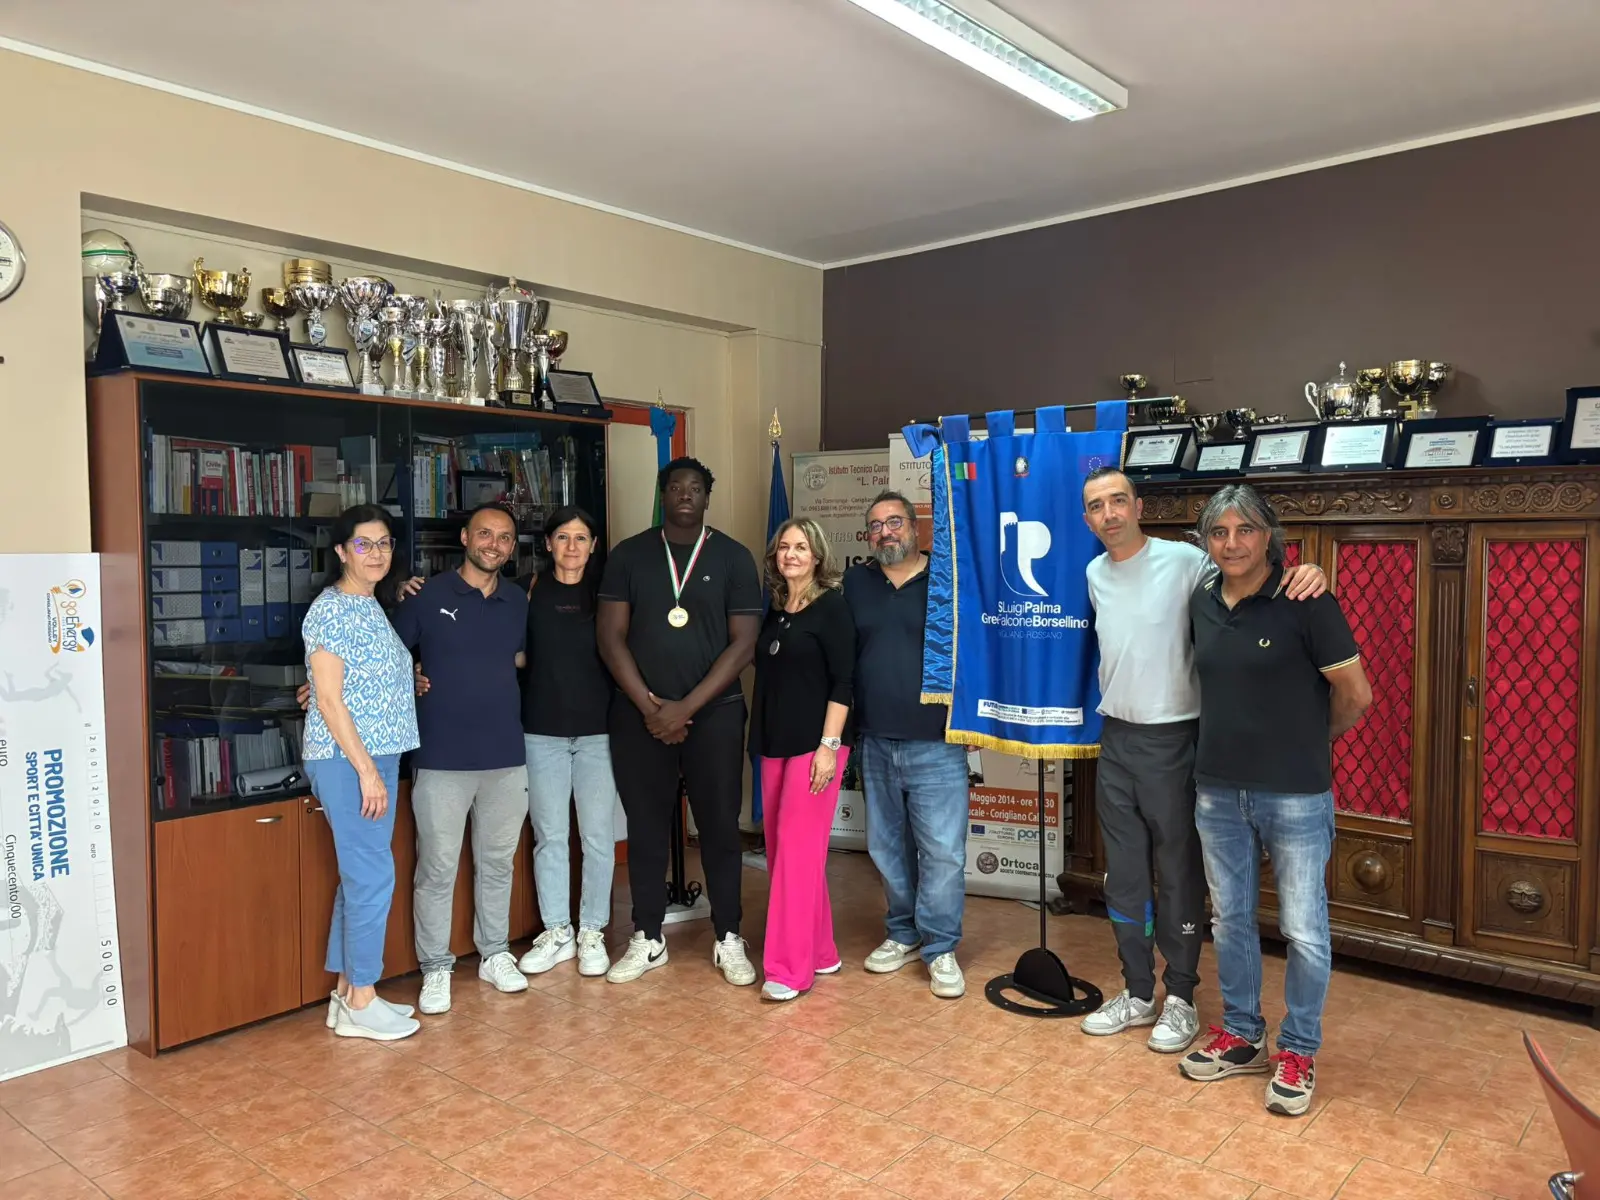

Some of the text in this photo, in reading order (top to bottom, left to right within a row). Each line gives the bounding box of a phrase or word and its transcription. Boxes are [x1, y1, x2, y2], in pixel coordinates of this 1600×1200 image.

[850, 464, 873, 474] Tecnico
[899, 461, 932, 470] ISTITUTO
[25, 751, 40, 792] SPORT
[27, 793, 40, 803] E
[970, 792, 997, 805] Maggio
[998, 794, 1015, 804] 2014
[1020, 799, 1033, 807] ore
[43, 748, 70, 879] PROMOZIONE
[990, 808, 1027, 821] Corigliano
[1028, 812, 1056, 824] Calbro
[30, 842, 45, 882] UNICA
[1000, 857, 1040, 871] Ortoca
[4, 834, 22, 919] Cinquecento/00
